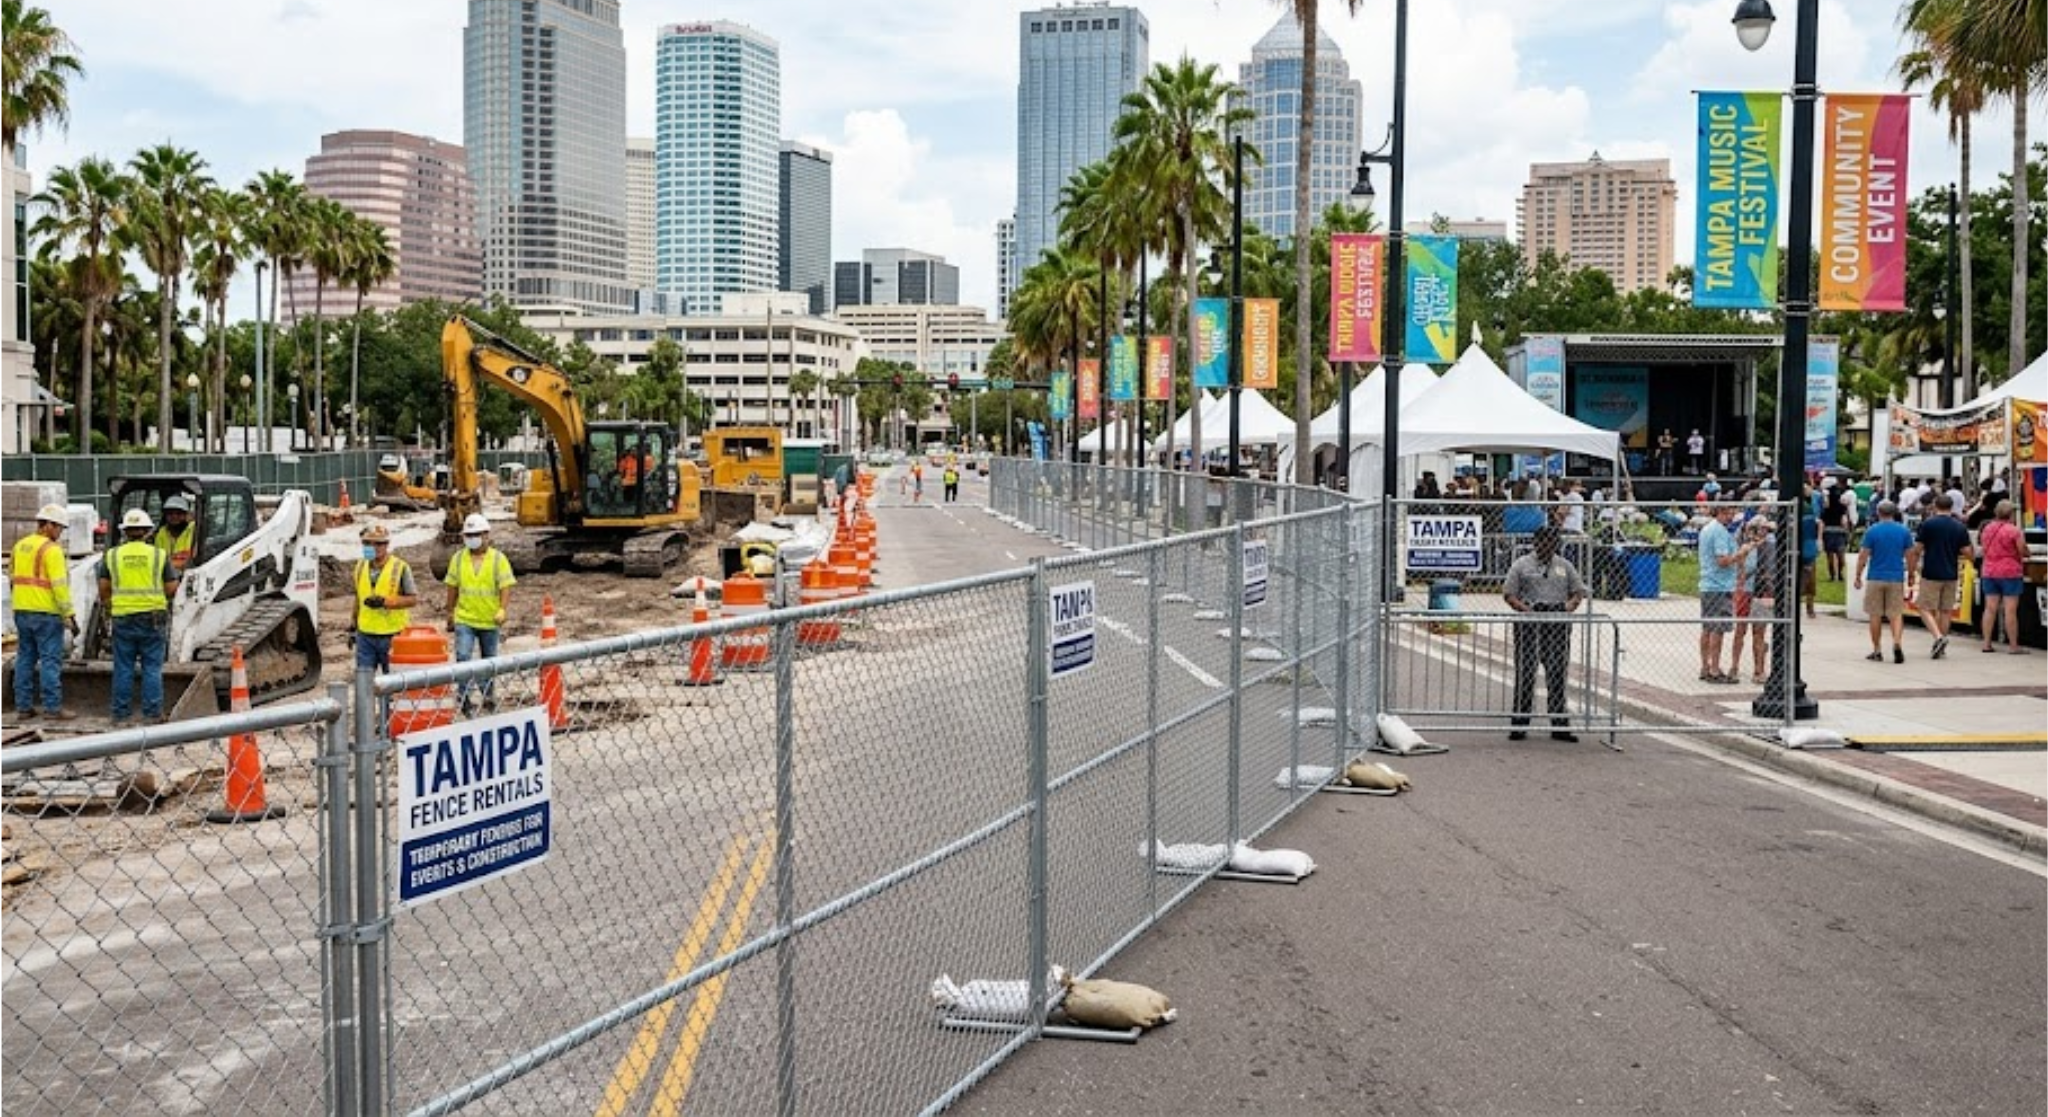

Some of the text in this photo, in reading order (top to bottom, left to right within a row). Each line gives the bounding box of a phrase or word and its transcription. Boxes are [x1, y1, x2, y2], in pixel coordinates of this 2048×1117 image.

[1705, 104, 1738, 291] TAMPA MUSIC
[1738, 117, 1768, 245] FESTIVAL
[1830, 105, 1864, 284] COMMUNITY
[1866, 153, 1896, 243] EVENT
[1410, 520, 1477, 538] TAMPA
[406, 719, 543, 798] TAMPA
[410, 772, 544, 829] FENCE RENTALS
